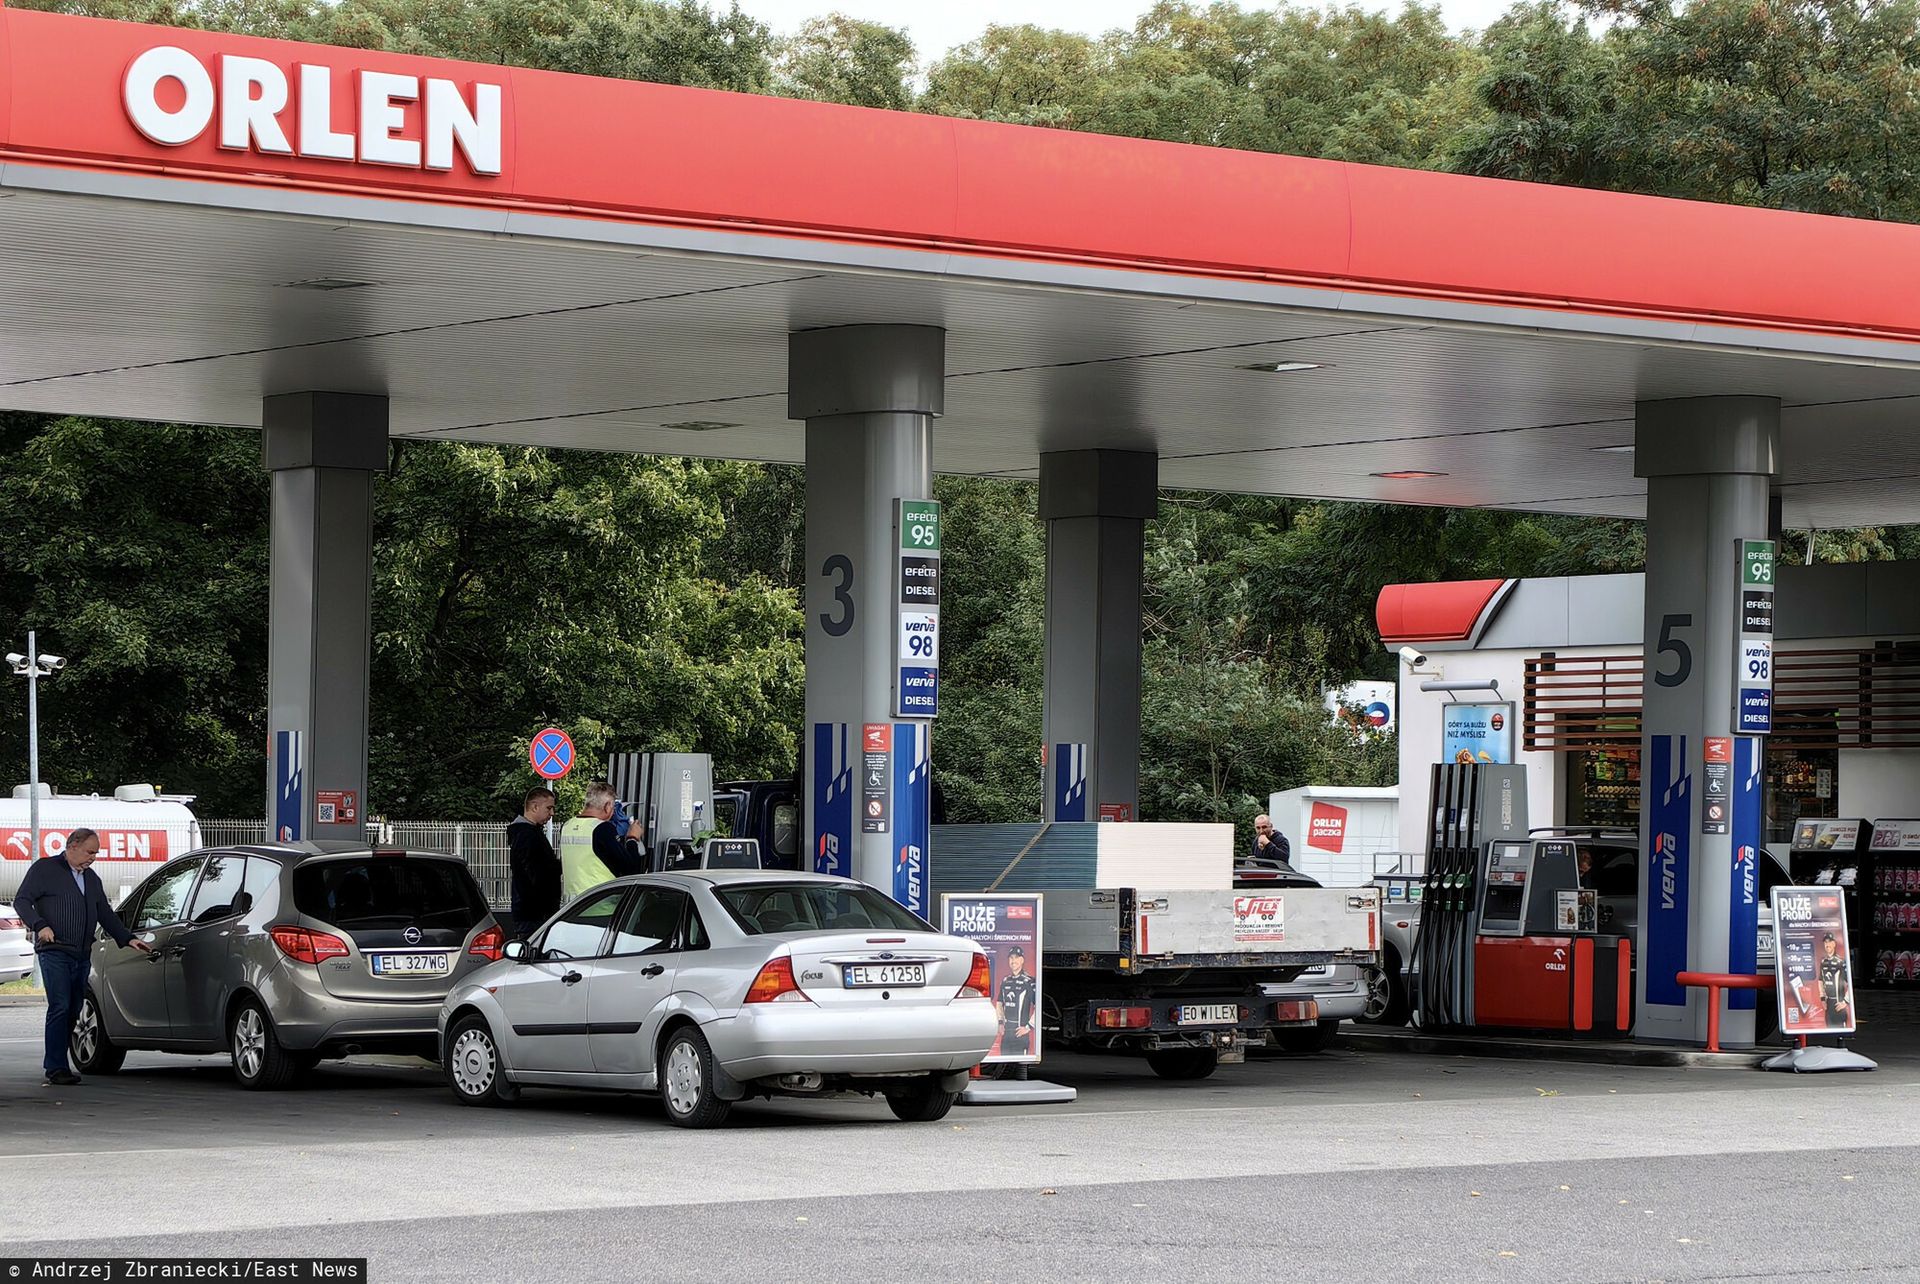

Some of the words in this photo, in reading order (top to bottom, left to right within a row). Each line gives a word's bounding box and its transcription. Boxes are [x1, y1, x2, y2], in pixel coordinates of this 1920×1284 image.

[122, 45, 501, 175] ORLEN
[911, 525, 935, 546] 95
[1751, 562, 1771, 581] 95
[820, 554, 855, 637] 3
[905, 586, 937, 596] DIESEL
[905, 622, 935, 632] verva
[1746, 616, 1771, 626] DIESEL
[909, 635, 933, 657] 98
[1654, 613, 1692, 688] 5
[1745, 648, 1770, 657] verva
[1748, 660, 1768, 679] 98
[905, 677, 935, 687] verva
[905, 695, 935, 706] DIESEL
[1745, 697, 1769, 707] verva
[1744, 714, 1769, 723] DIESEL
[1447, 729, 1459, 738] NIŻ
[1460, 729, 1487, 738] MYŚLISZ
[1313, 818, 1342, 828] ORLEN
[1313, 828, 1342, 838] paczka
[44, 832, 150, 858] OEN
[1661, 832, 1676, 909] verva
[1743, 845, 1755, 904] verva
[907, 845, 921, 911] verva
[1780, 894, 1811, 911] DUŻE
[953, 902, 996, 922] DUŻE
[1780, 911, 1812, 921] PROMO
[952, 921, 996, 933] PROMO
[382, 957, 401, 970] EL
[406, 955, 446, 970] 327WG
[1545, 963, 1566, 971] ORLEN
[880, 966, 922, 983] 61258
[1200, 1005, 1236, 1019] WILEX
